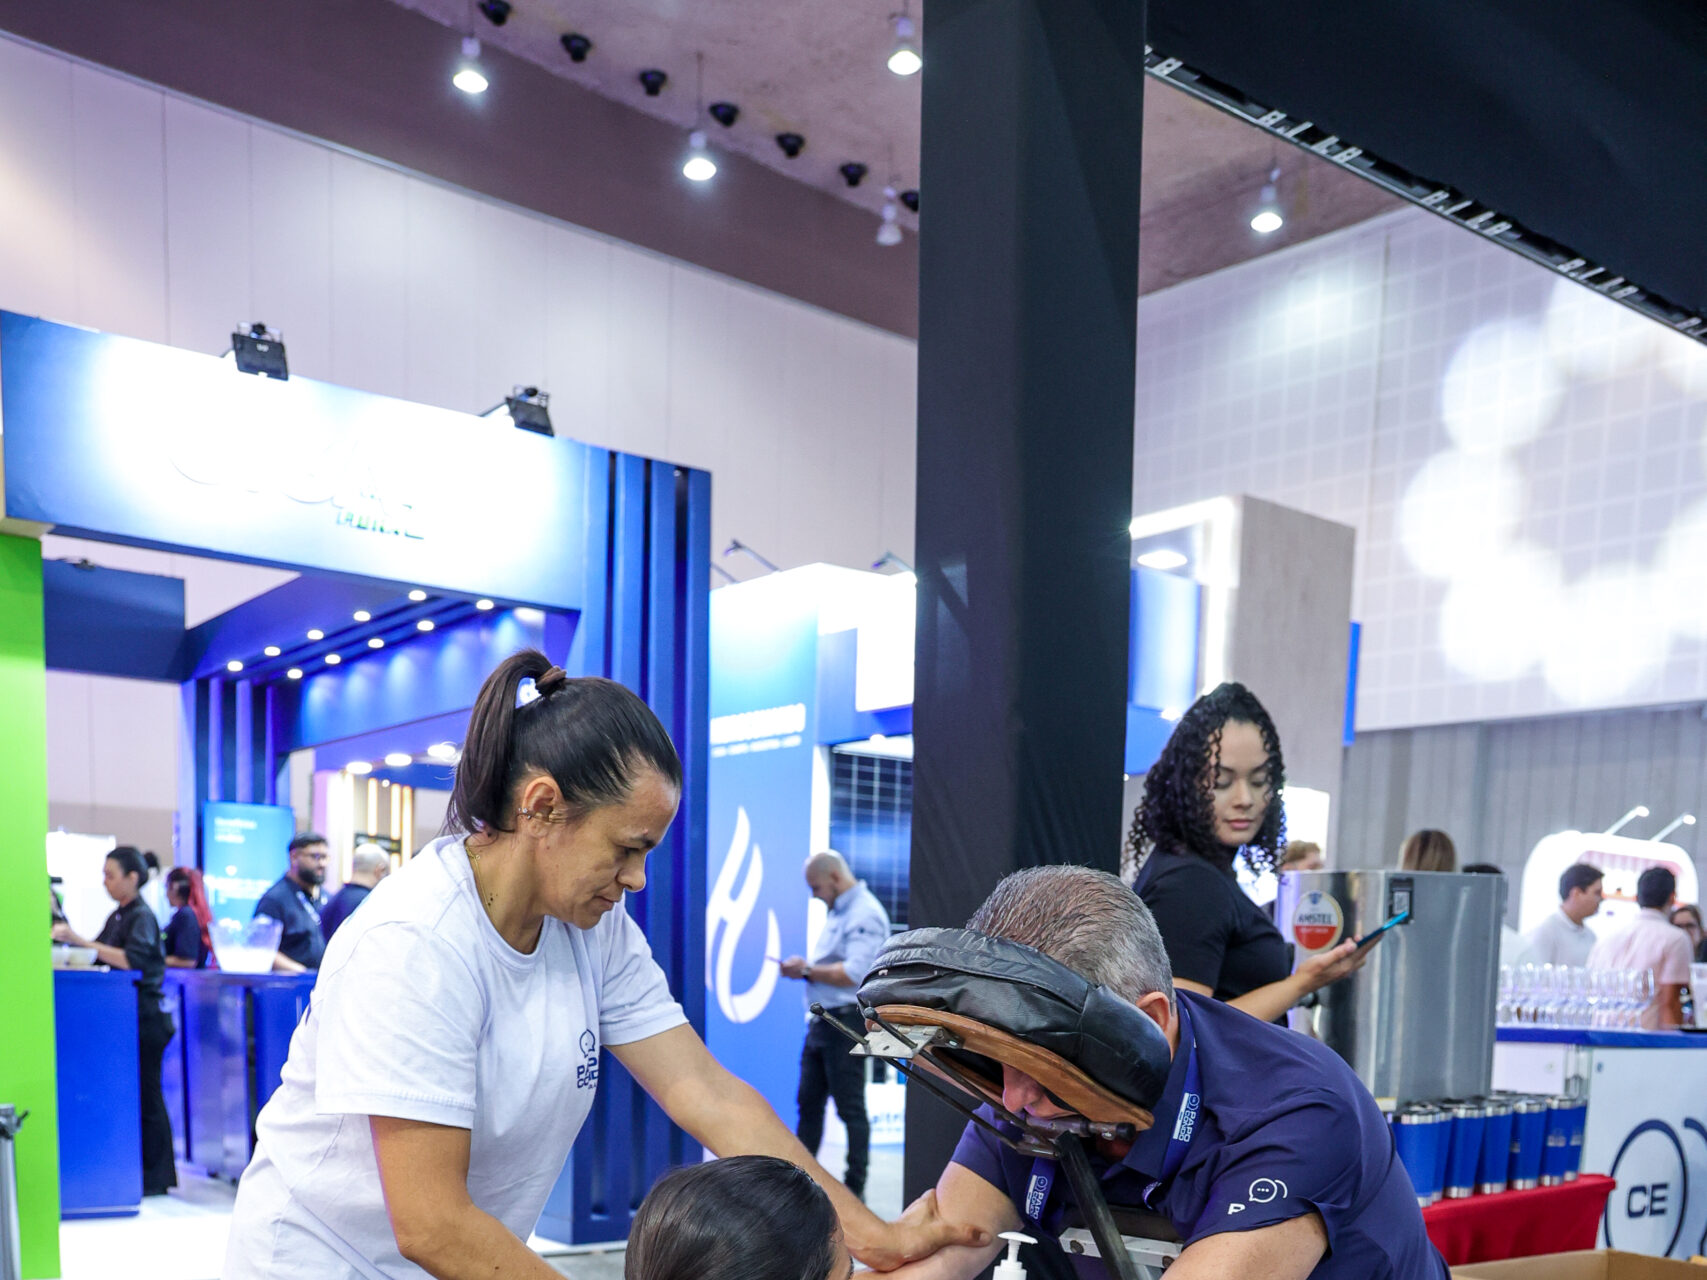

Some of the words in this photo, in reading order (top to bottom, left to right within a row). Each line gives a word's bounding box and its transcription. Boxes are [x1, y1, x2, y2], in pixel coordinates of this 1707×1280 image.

[1178, 1110, 1190, 1141] CONDO
[1183, 1111, 1196, 1142] PAPO
[1627, 1183, 1668, 1218] CE
